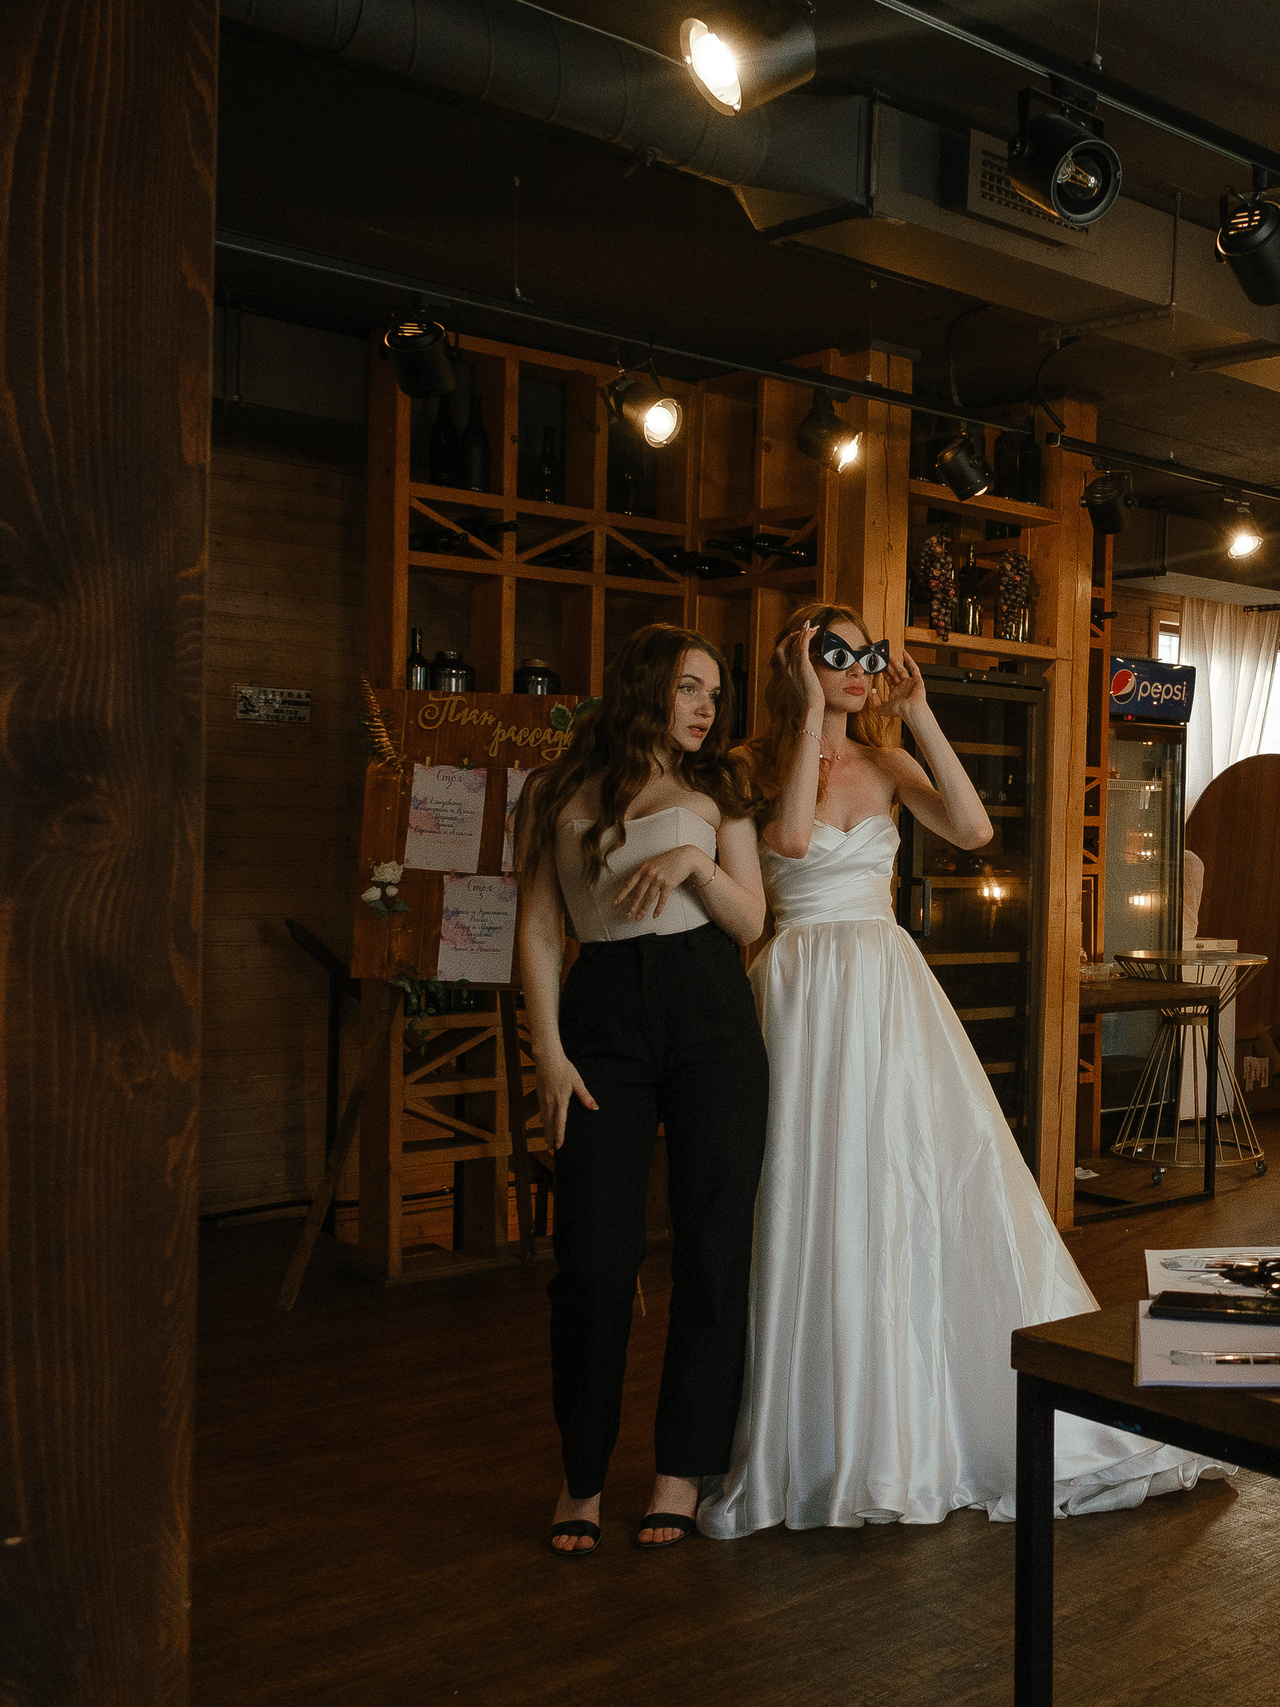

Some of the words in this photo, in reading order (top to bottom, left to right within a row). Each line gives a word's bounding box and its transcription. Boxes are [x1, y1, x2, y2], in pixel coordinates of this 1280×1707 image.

[1137, 681, 1187, 704] pepsi
[418, 693, 496, 730] План
[489, 720, 575, 762] рассадк
[436, 768, 464, 783] Стол
[446, 782, 453, 790] 2
[467, 880, 495, 892] Стол
